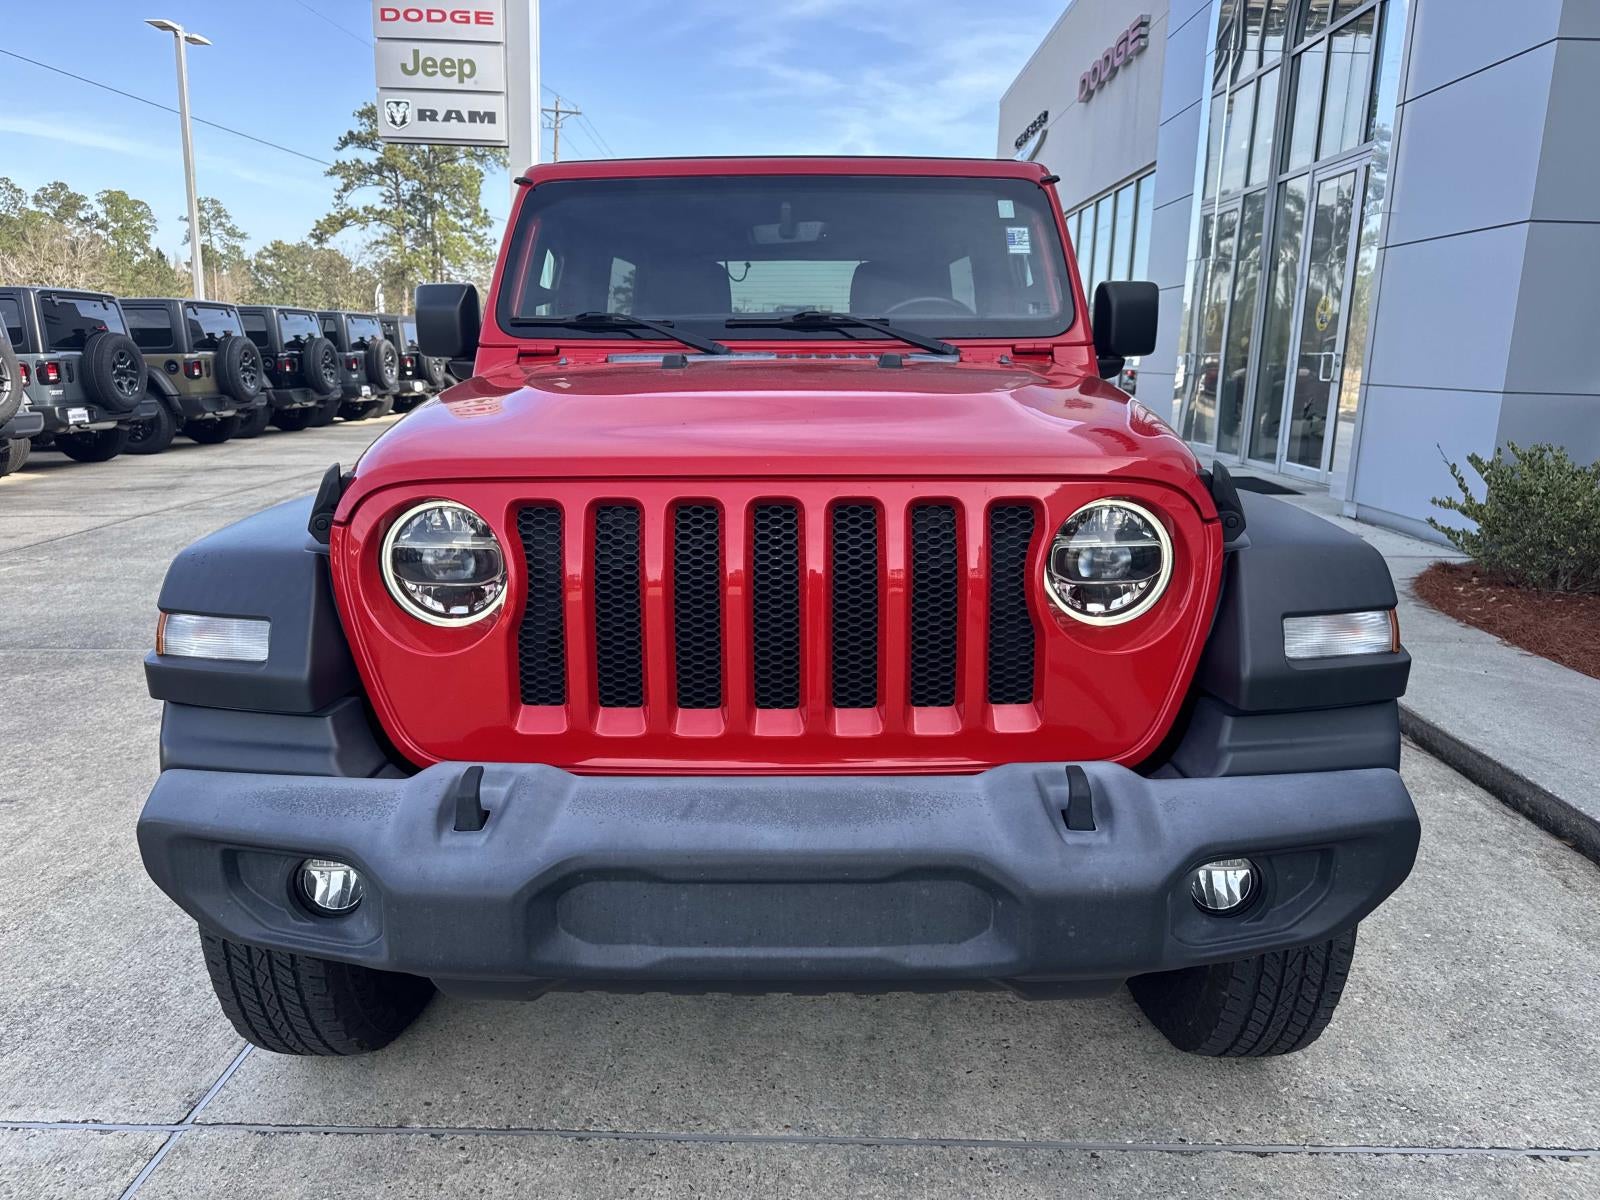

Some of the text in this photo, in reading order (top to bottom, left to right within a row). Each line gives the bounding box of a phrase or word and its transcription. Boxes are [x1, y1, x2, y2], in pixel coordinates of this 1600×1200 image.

[380, 8, 494, 25] DODGE
[400, 49, 476, 84] Jeep
[1078, 14, 1152, 103] DODGE
[417, 109, 496, 124] RAM
